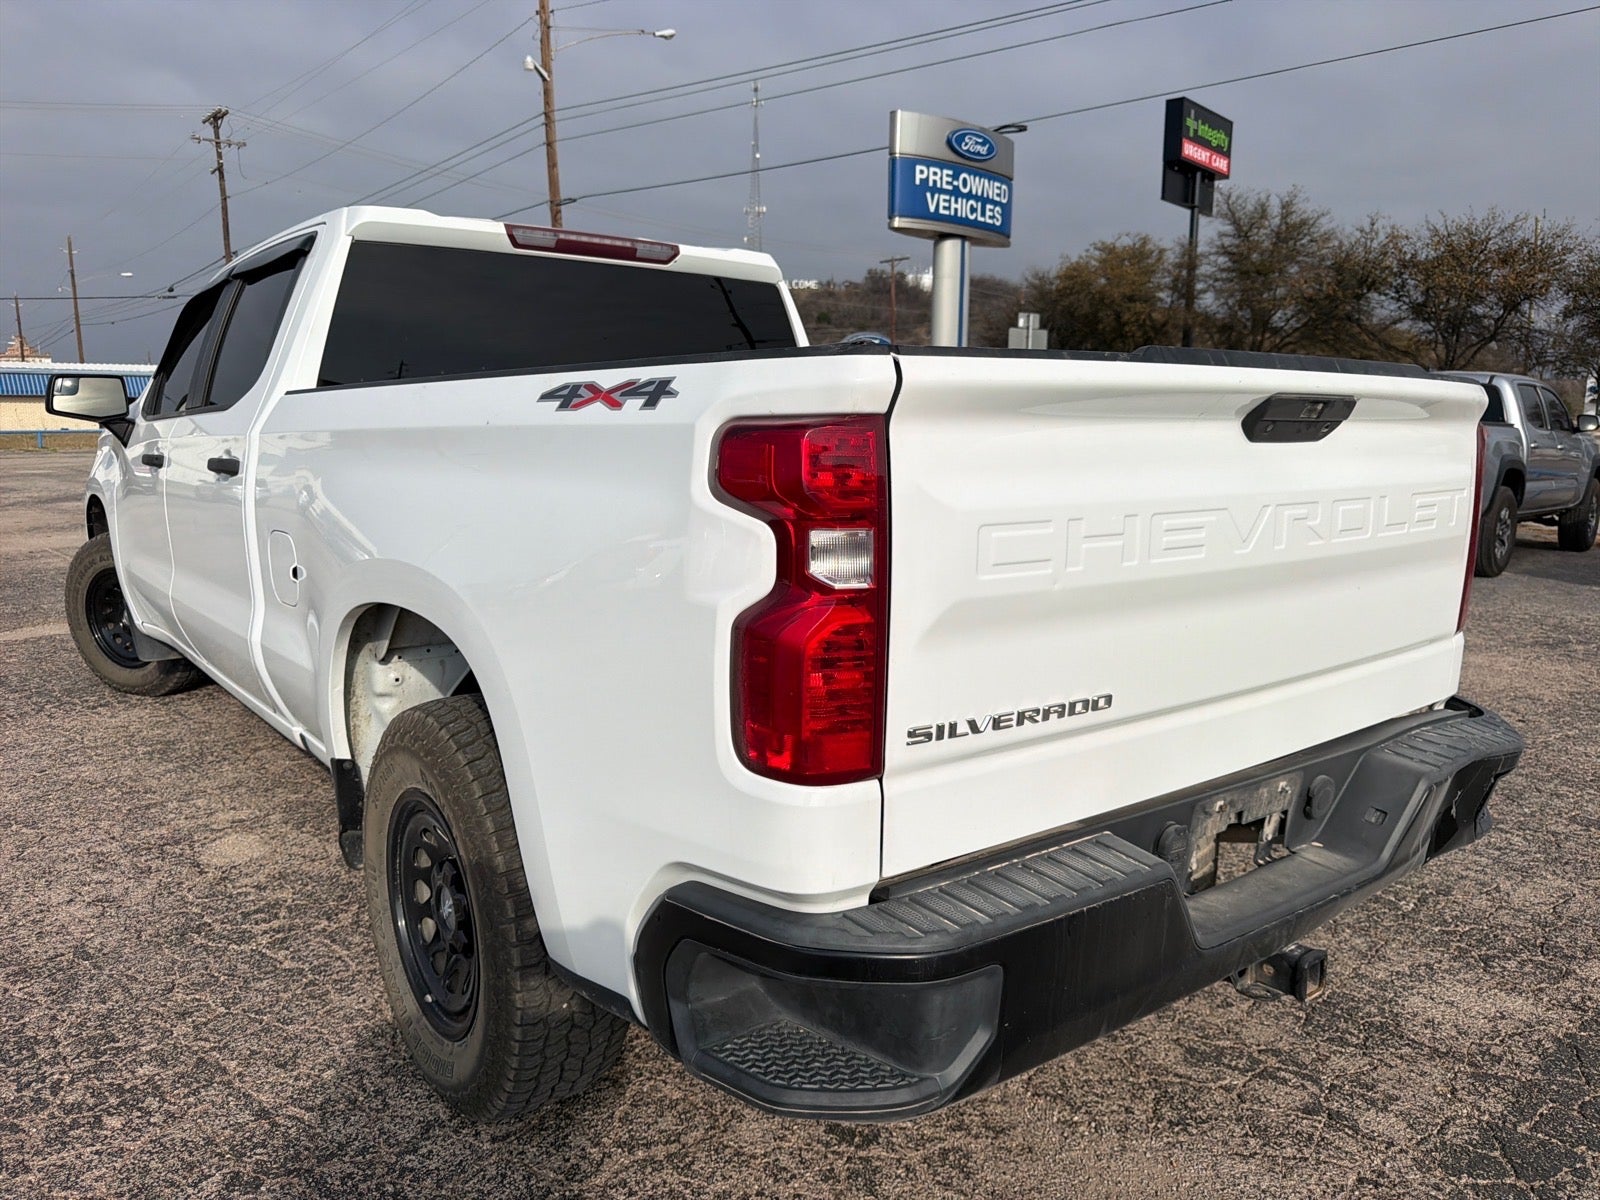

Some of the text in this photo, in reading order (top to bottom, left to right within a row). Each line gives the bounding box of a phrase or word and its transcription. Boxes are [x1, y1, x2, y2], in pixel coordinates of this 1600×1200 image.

[961, 134, 990, 155] Ford
[1198, 119, 1229, 151] Integrity
[1184, 142, 1229, 172] URGENT CARE
[915, 165, 1009, 204] PRE-OWNED
[926, 192, 1002, 226] VEHICLES
[976, 487, 1467, 580] CHEVROLET
[906, 692, 1113, 746] SILVERADO
